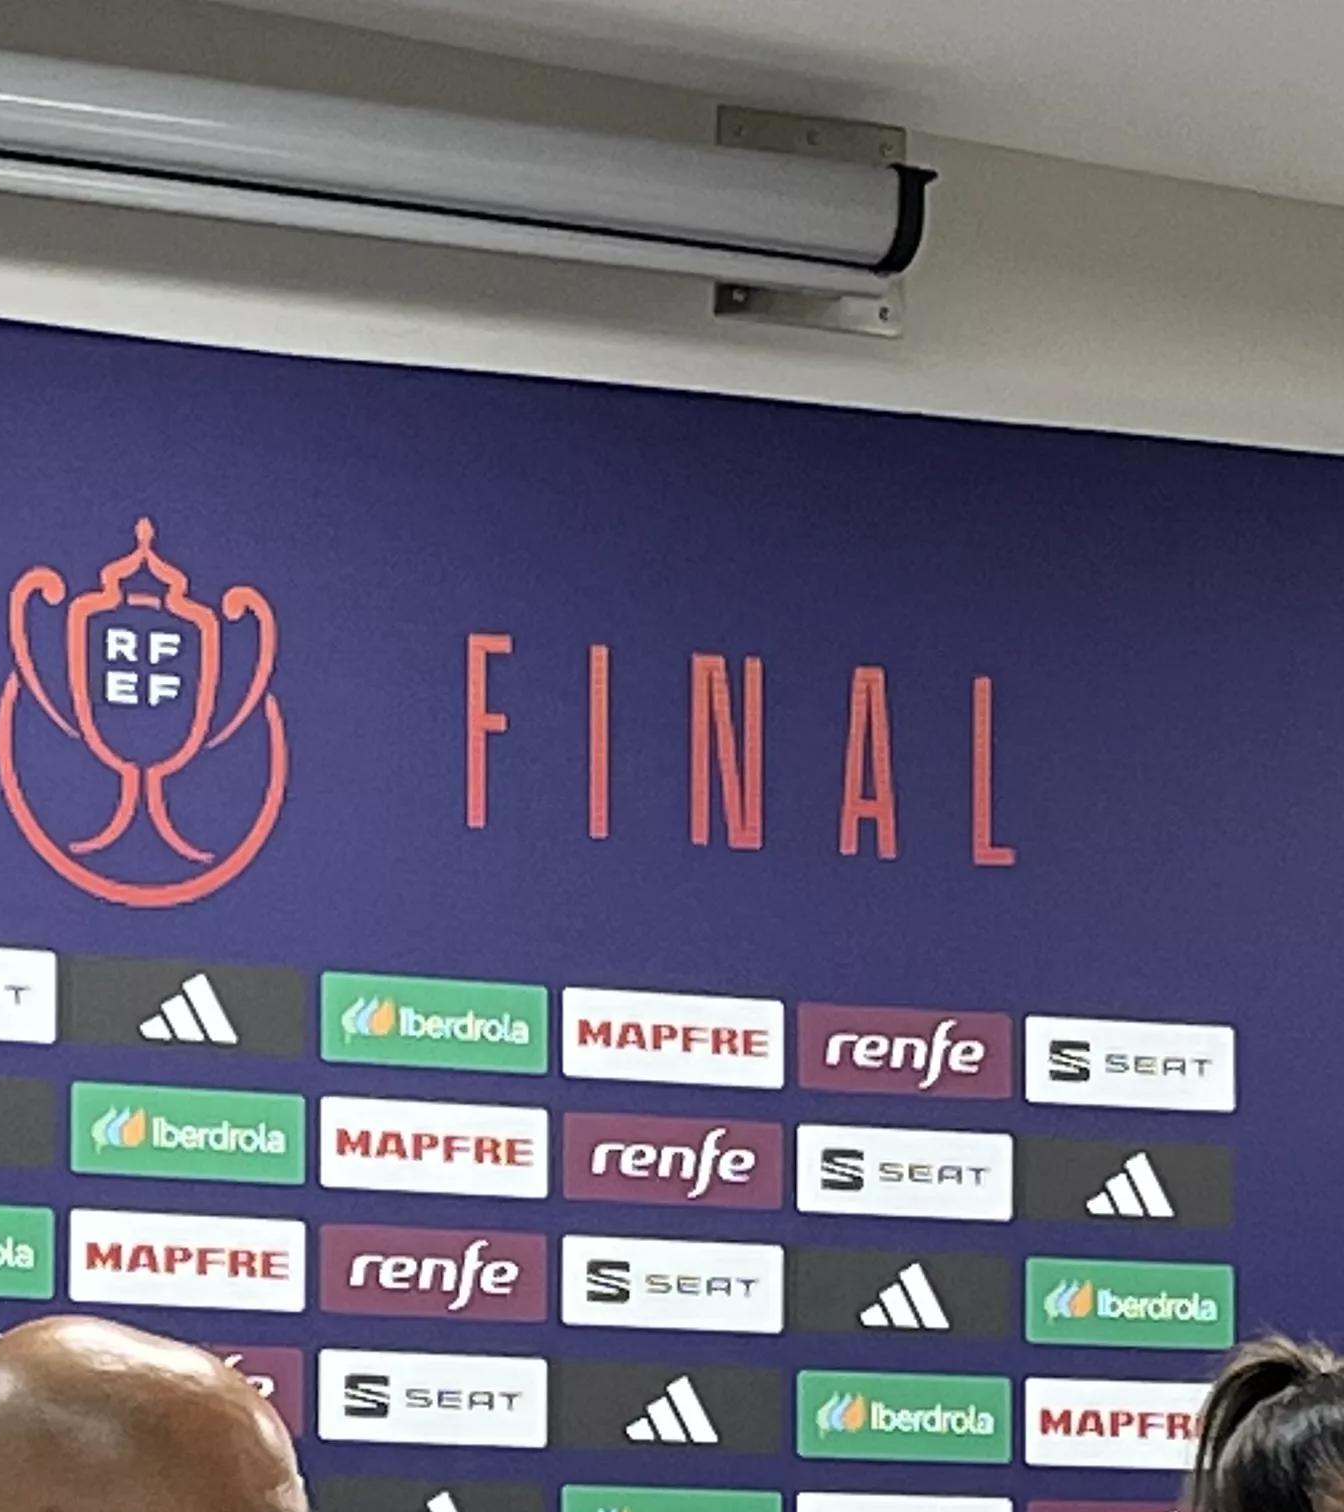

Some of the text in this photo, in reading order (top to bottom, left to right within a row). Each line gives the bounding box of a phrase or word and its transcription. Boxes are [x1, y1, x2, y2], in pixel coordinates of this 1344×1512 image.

[468, 634, 1014, 865] FINAL
[400, 1007, 528, 1043] Iberdrola
[579, 1020, 766, 1056] MAPFRE
[827, 1020, 983, 1088] renfe
[1105, 1054, 1210, 1075] SEAT
[153, 1117, 285, 1153] Iberdrola
[337, 1129, 531, 1166] MAPFRE
[592, 1129, 754, 1197] renfe
[879, 1163, 986, 1184] SEAT
[87, 1243, 286, 1279] MAPFRE
[350, 1240, 518, 1309] renfe
[646, 1275, 756, 1296] SEAT
[1098, 1289, 1216, 1320] Iberdrola
[406, 1389, 519, 1410] SEAT
[872, 1402, 994, 1434] Iberdrola
